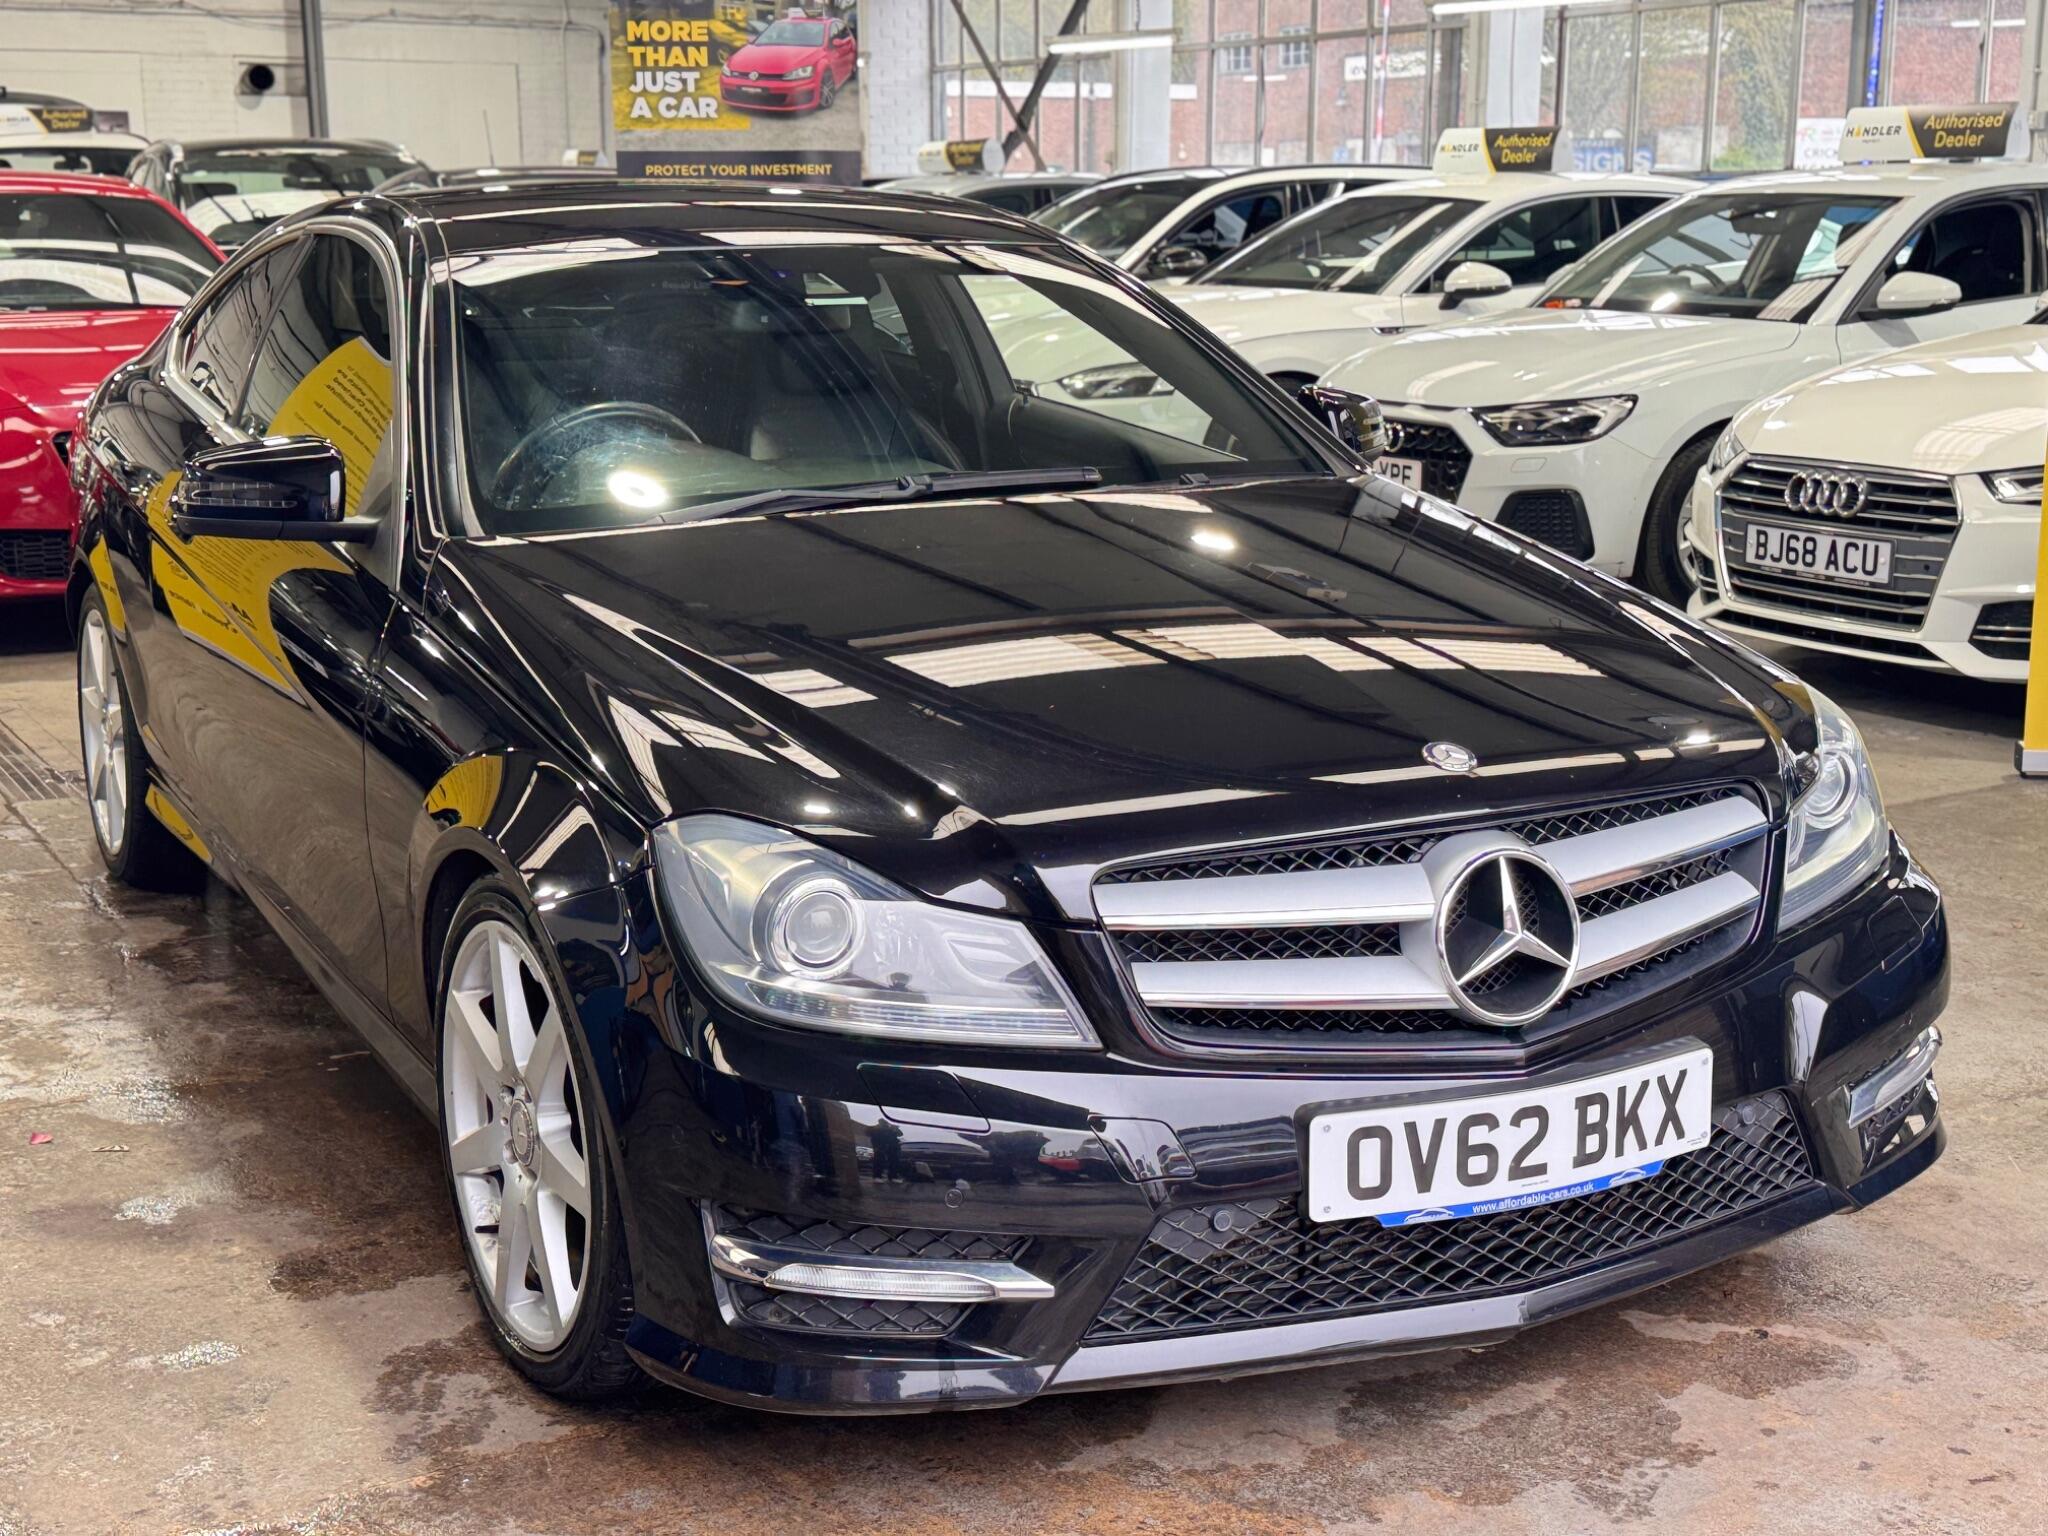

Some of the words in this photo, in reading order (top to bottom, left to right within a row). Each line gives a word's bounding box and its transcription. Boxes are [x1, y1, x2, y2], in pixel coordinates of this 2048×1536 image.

[626, 20, 709, 42] MORE
[627, 45, 709, 67] THAN
[629, 71, 700, 93] JUST
[630, 97, 653, 118] A
[657, 97, 719, 119] CAR
[1923, 110, 2006, 130] Authorised
[1494, 132, 1552, 148] Authorised
[1934, 130, 1985, 148] Dealer
[1501, 148, 1538, 164] Dealer
[645, 164, 706, 177] PROTECT
[710, 164, 747, 176] YOUR
[750, 163, 832, 176] INVESTMENT
[1754, 528, 1818, 568] BJ68
[1824, 539, 1880, 576] ACU
[1346, 1103, 1550, 1202] OV62
[1572, 1068, 1688, 1170] BKX
[1472, 1181, 1594, 1215] www.affordable-cars.co.uk
